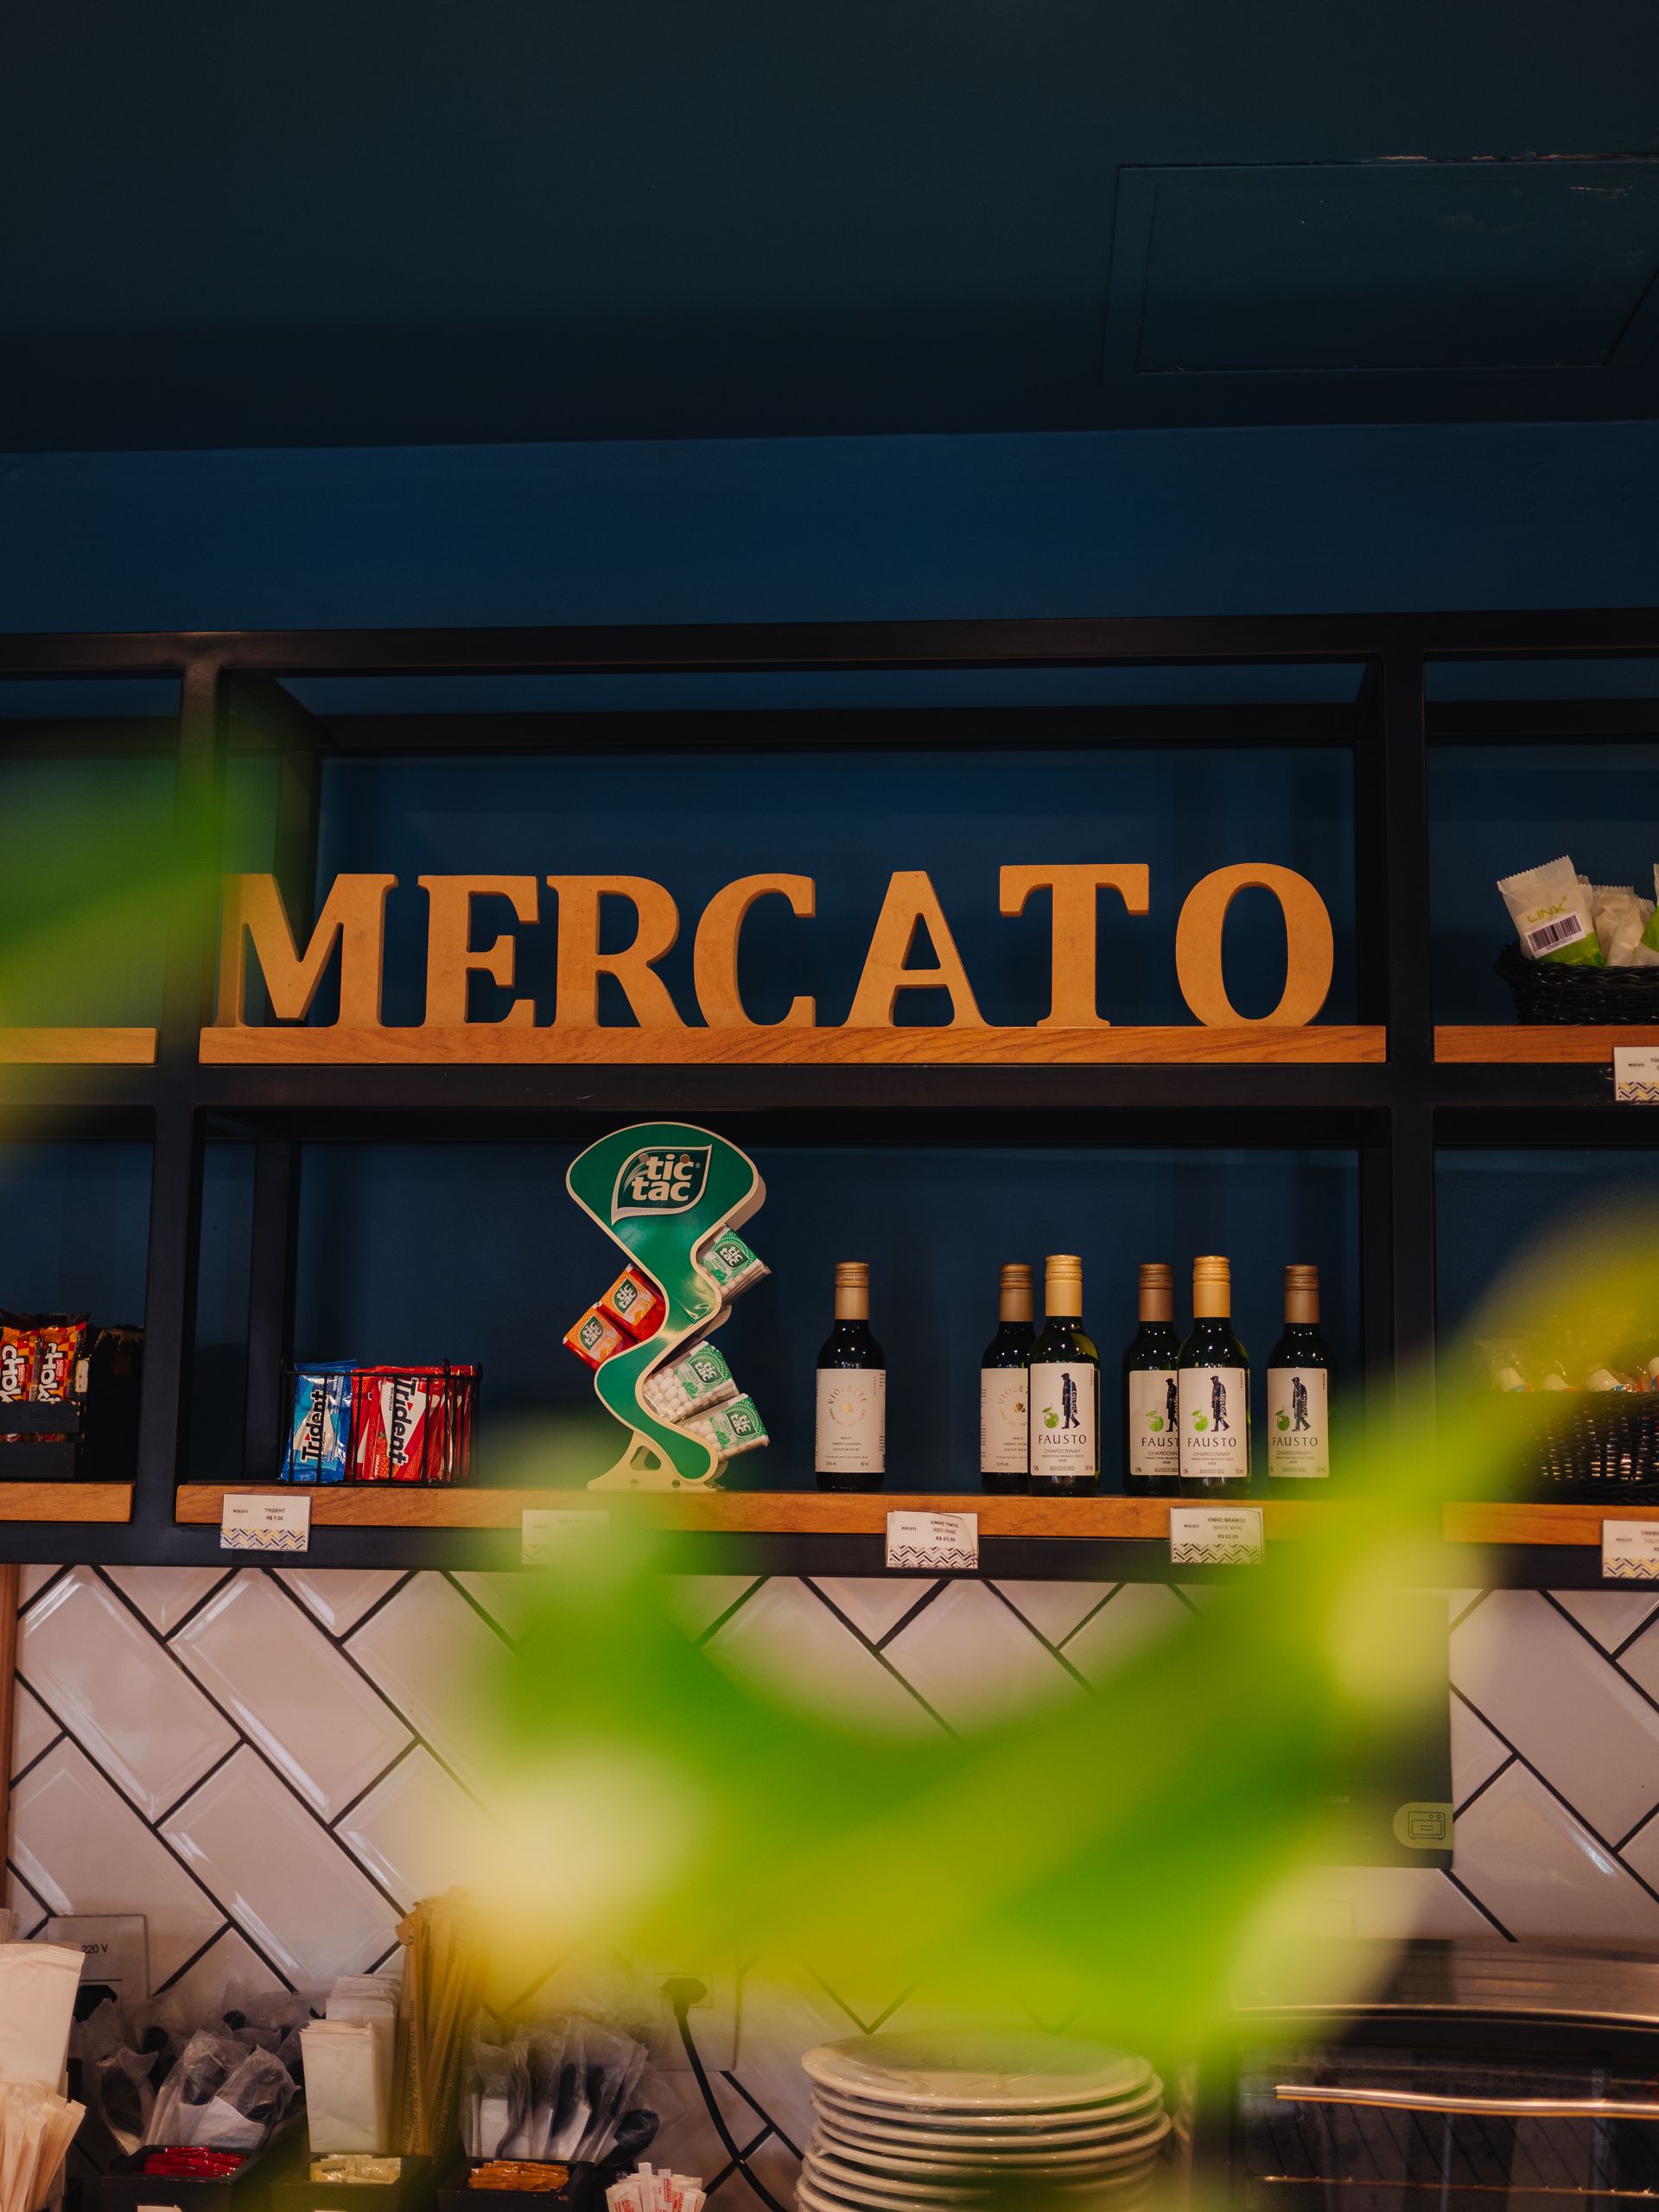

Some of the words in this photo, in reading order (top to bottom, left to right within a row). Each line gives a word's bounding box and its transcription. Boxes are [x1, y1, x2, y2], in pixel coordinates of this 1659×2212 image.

[1527, 903, 1567, 923] LINX
[214, 862, 1333, 1028] MERCATO
[645, 1154, 695, 1181] tic
[631, 1177, 691, 1202] tac
[719, 1248, 738, 1267] tac
[728, 1246, 744, 1262] tic
[616, 1284, 632, 1300] tic
[619, 1290, 637, 1309] tac
[582, 1322, 598, 1338] tic
[584, 1328, 603, 1346] tac
[694, 1362, 710, 1382] tac
[703, 1361, 717, 1378] tic
[300, 1389, 326, 1463] Trident
[390, 1377, 419, 1465] Trident
[729, 1413, 744, 1434] tac
[740, 1414, 752, 1433] tic
[1038, 1434, 1087, 1445] FAUSTO
[1187, 1437, 1236, 1447] FAUSTO
[1272, 1436, 1319, 1447] FAUSTO
[81, 1944, 99, 1954] 220
[100, 1942, 109, 1953] V
[408, 2030, 416, 2069] VEGETAL
